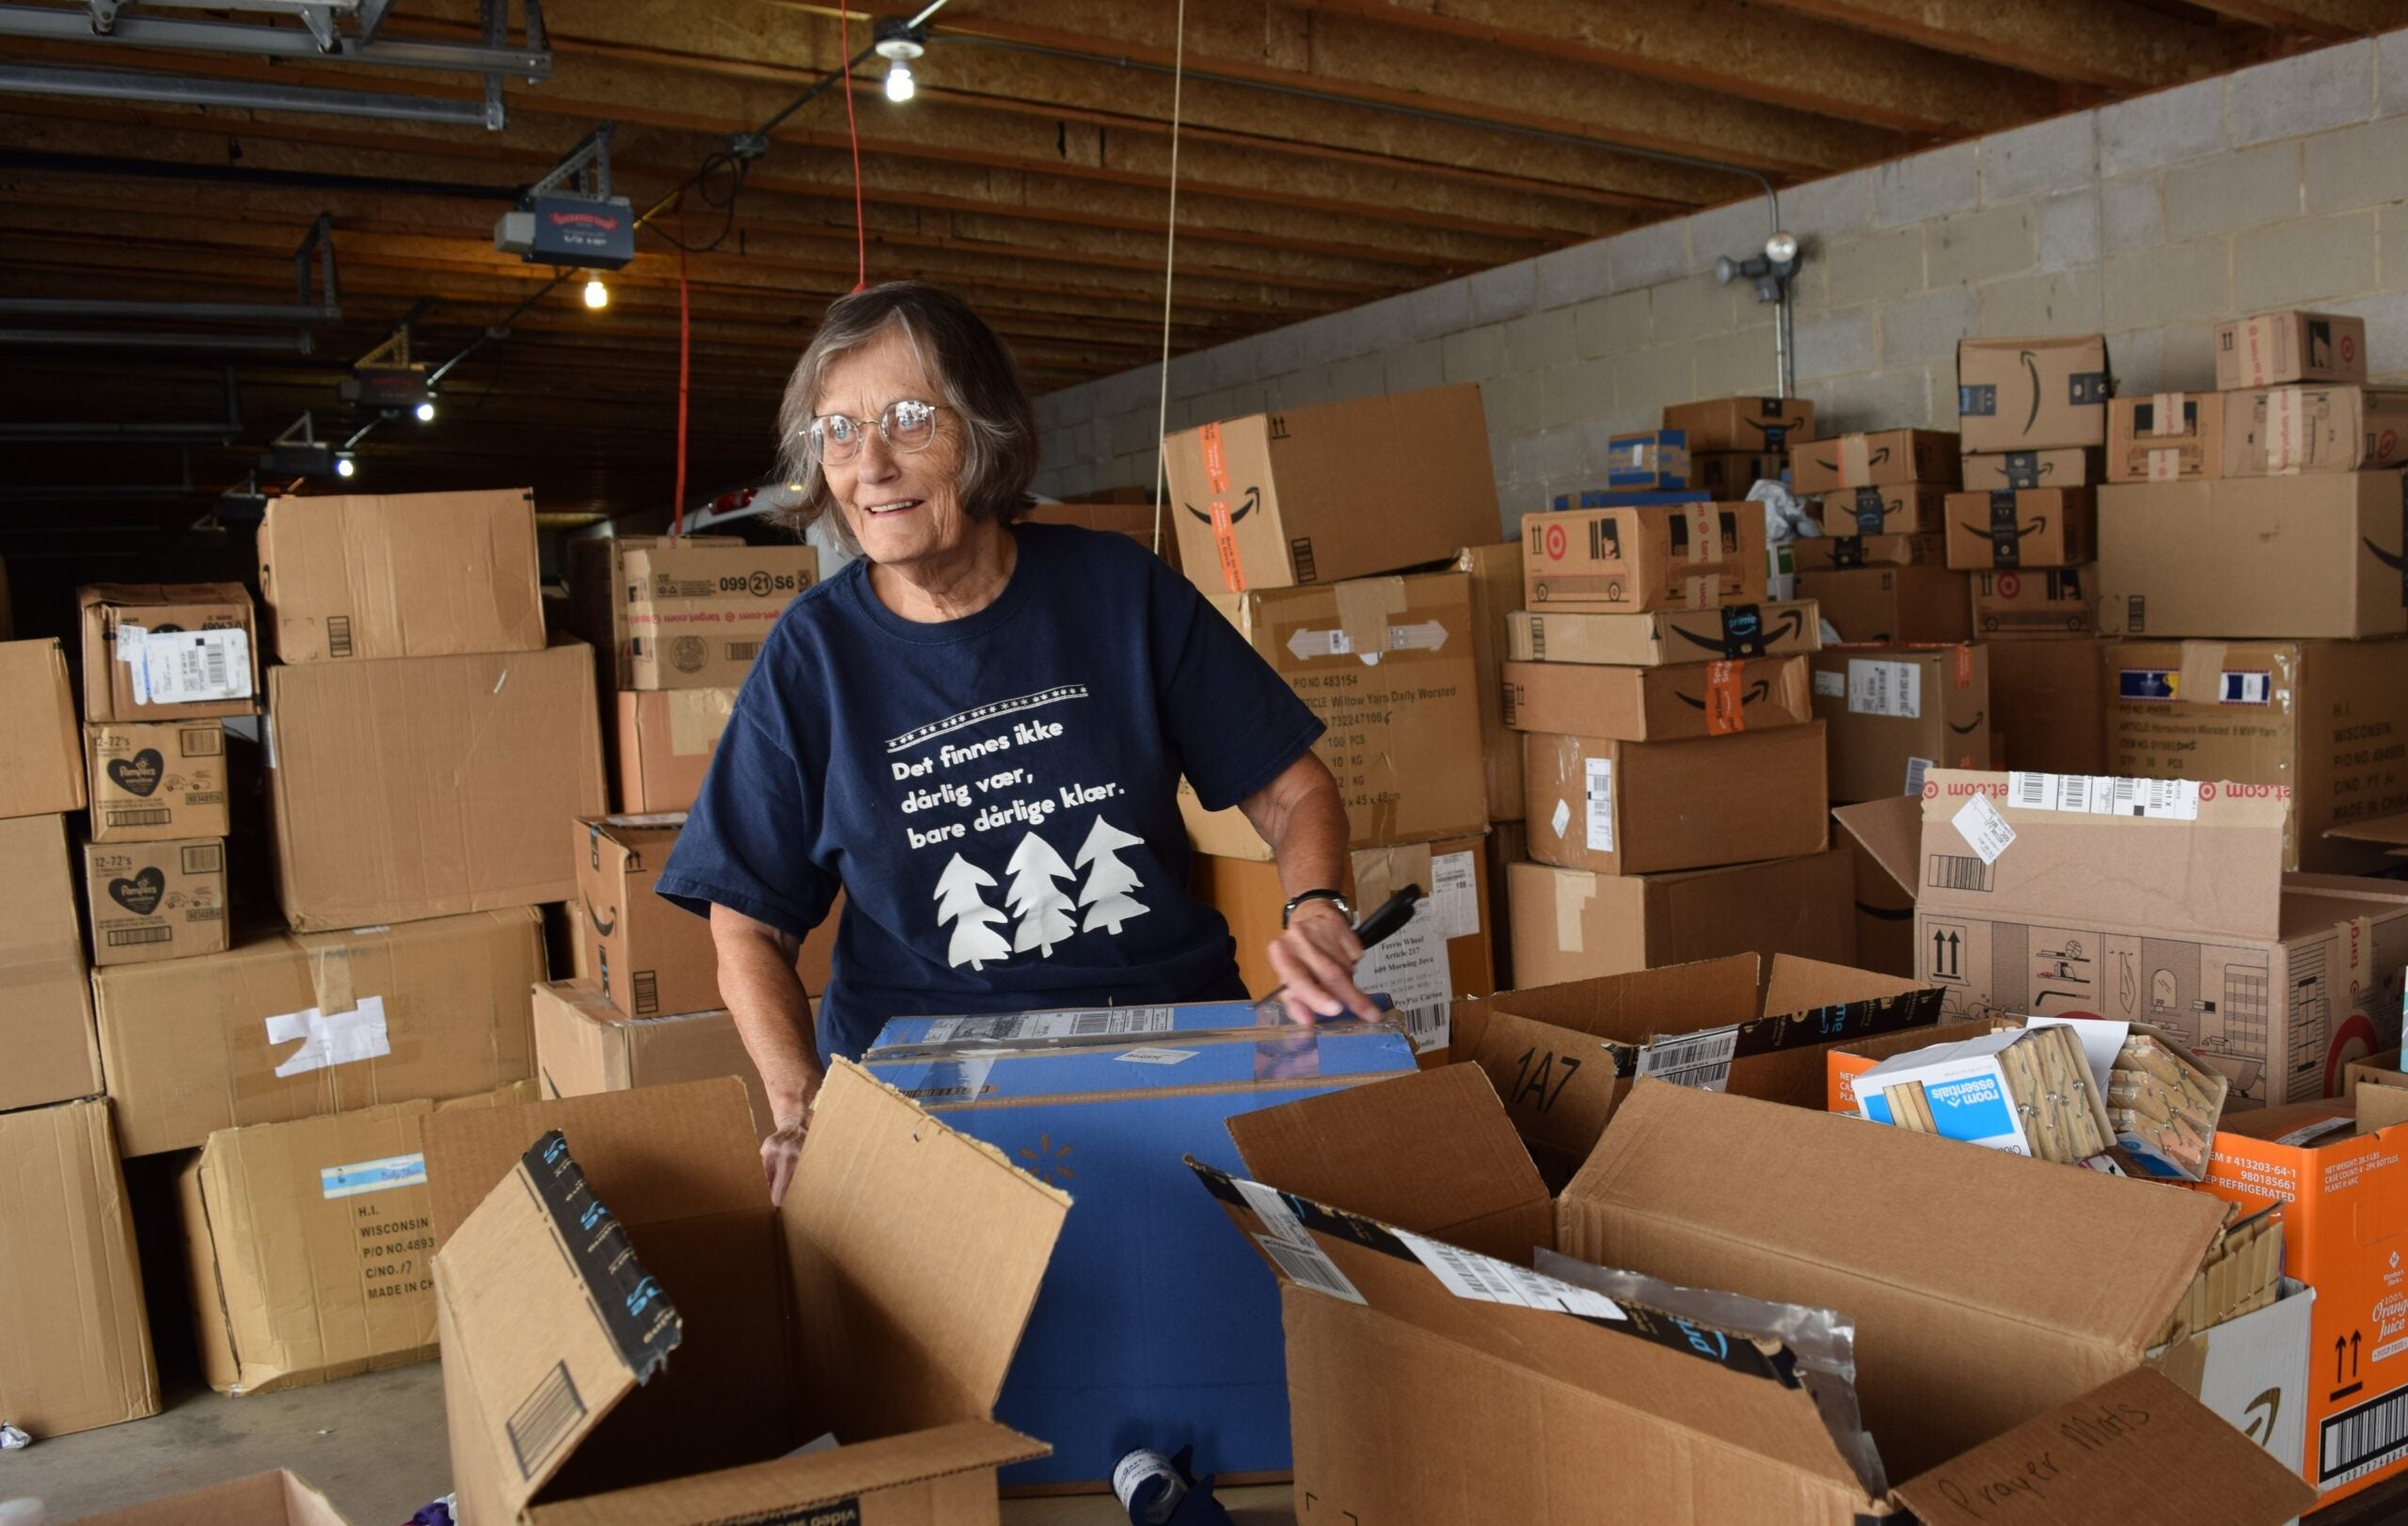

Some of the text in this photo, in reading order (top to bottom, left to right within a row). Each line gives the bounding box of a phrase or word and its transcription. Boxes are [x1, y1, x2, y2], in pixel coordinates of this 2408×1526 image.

[720, 577, 747, 591] 099
[754, 577, 768, 590] 21
[774, 576, 795, 590] S6
[664, 612, 720, 623] target.com
[1729, 614, 1757, 628] prime
[1323, 675, 1357, 687] 483154
[1331, 696, 1364, 707] Willow
[1367, 692, 1388, 704] Yarn
[1392, 691, 1416, 704] Daily
[1418, 685, 1456, 700] Worsted
[892, 720, 1063, 780] Det finnes ikke
[1328, 736, 1345, 748] 100
[119, 765, 156, 778] Pampers
[901, 768, 1033, 814] dårlig vær,
[907, 782, 1125, 849] bare dårlige klær.
[95, 856, 132, 867] 12-72's
[120, 884, 157, 897] Pampers
[1382, 936, 1424, 950] Ferris Wheel
[1385, 946, 1420, 961] Article 217
[1388, 960, 1417, 972] Morning
[1418, 957, 1434, 967] Java
[1420, 991, 1443, 1002] Carton
[1510, 1046, 1581, 1114] 1A7
[1931, 1077, 1995, 1103] essentials
[1963, 1089, 2000, 1105] room
[2226, 1155, 2231, 1164] #
[2234, 1156, 2296, 1179] 413203-64-1
[2324, 1171, 2340, 1184] CASE
[2376, 1154, 2399, 1170] BOTTLES
[2325, 1164, 2337, 1175] NET
[2370, 1151, 2380, 1162] LBS
[2241, 1170, 2296, 1191] 980185661
[2324, 1183, 2340, 1194] PLANT
[2220, 1177, 2295, 1203] REFRIGERATED
[358, 1205, 380, 1217] H.I.
[360, 1217, 429, 1237] WISCONSIN
[363, 1246, 383, 1258] P/O
[368, 1284, 402, 1298] MADE
[404, 1281, 417, 1294] IN
[2378, 1313, 2406, 1343] Juice
[1939, 1452, 2059, 1520] Prayer
[810, 1508, 857, 1526] video
